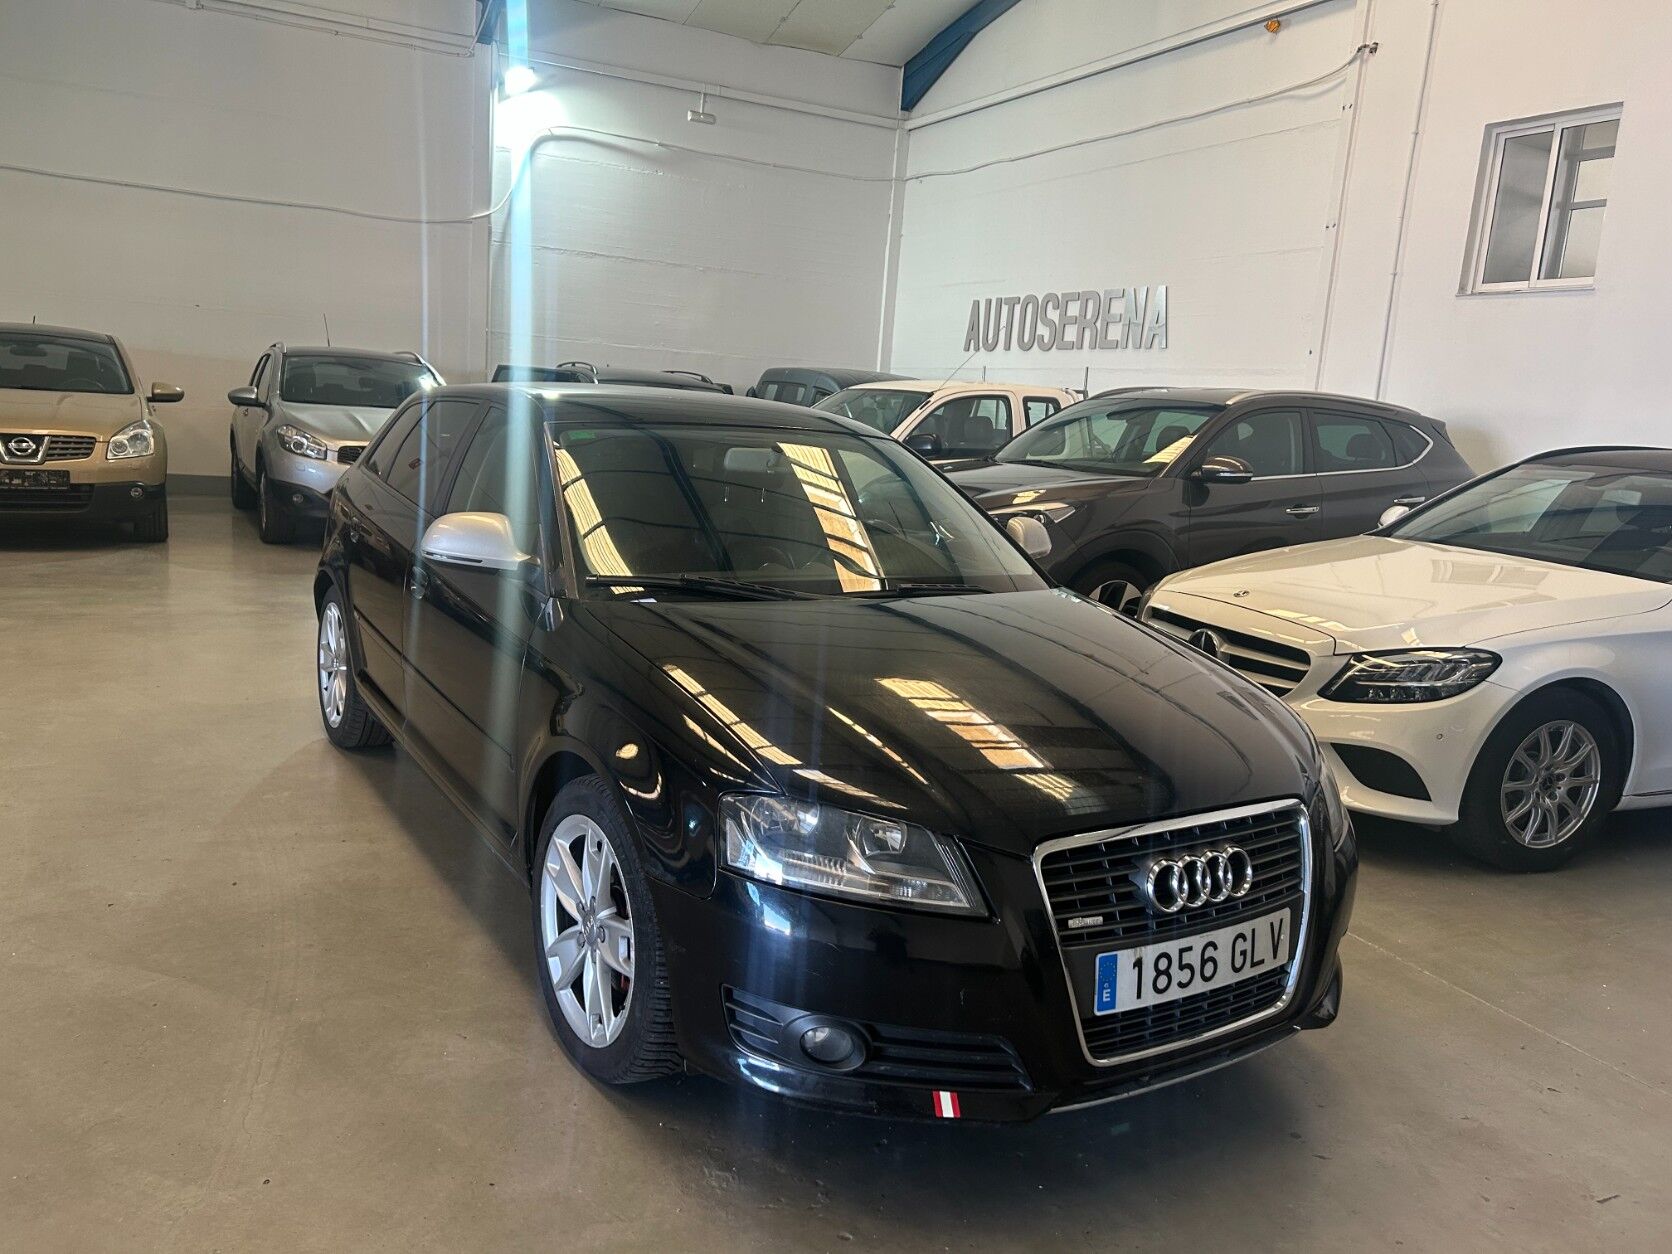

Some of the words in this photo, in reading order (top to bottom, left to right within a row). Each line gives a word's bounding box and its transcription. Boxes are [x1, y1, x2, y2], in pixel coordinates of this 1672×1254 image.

[963, 285, 1167, 352] AUTOSERENA
[1132, 940, 1219, 1000] 1856
[1231, 918, 1284, 974] GLV
[1103, 989, 1111, 1002] E
